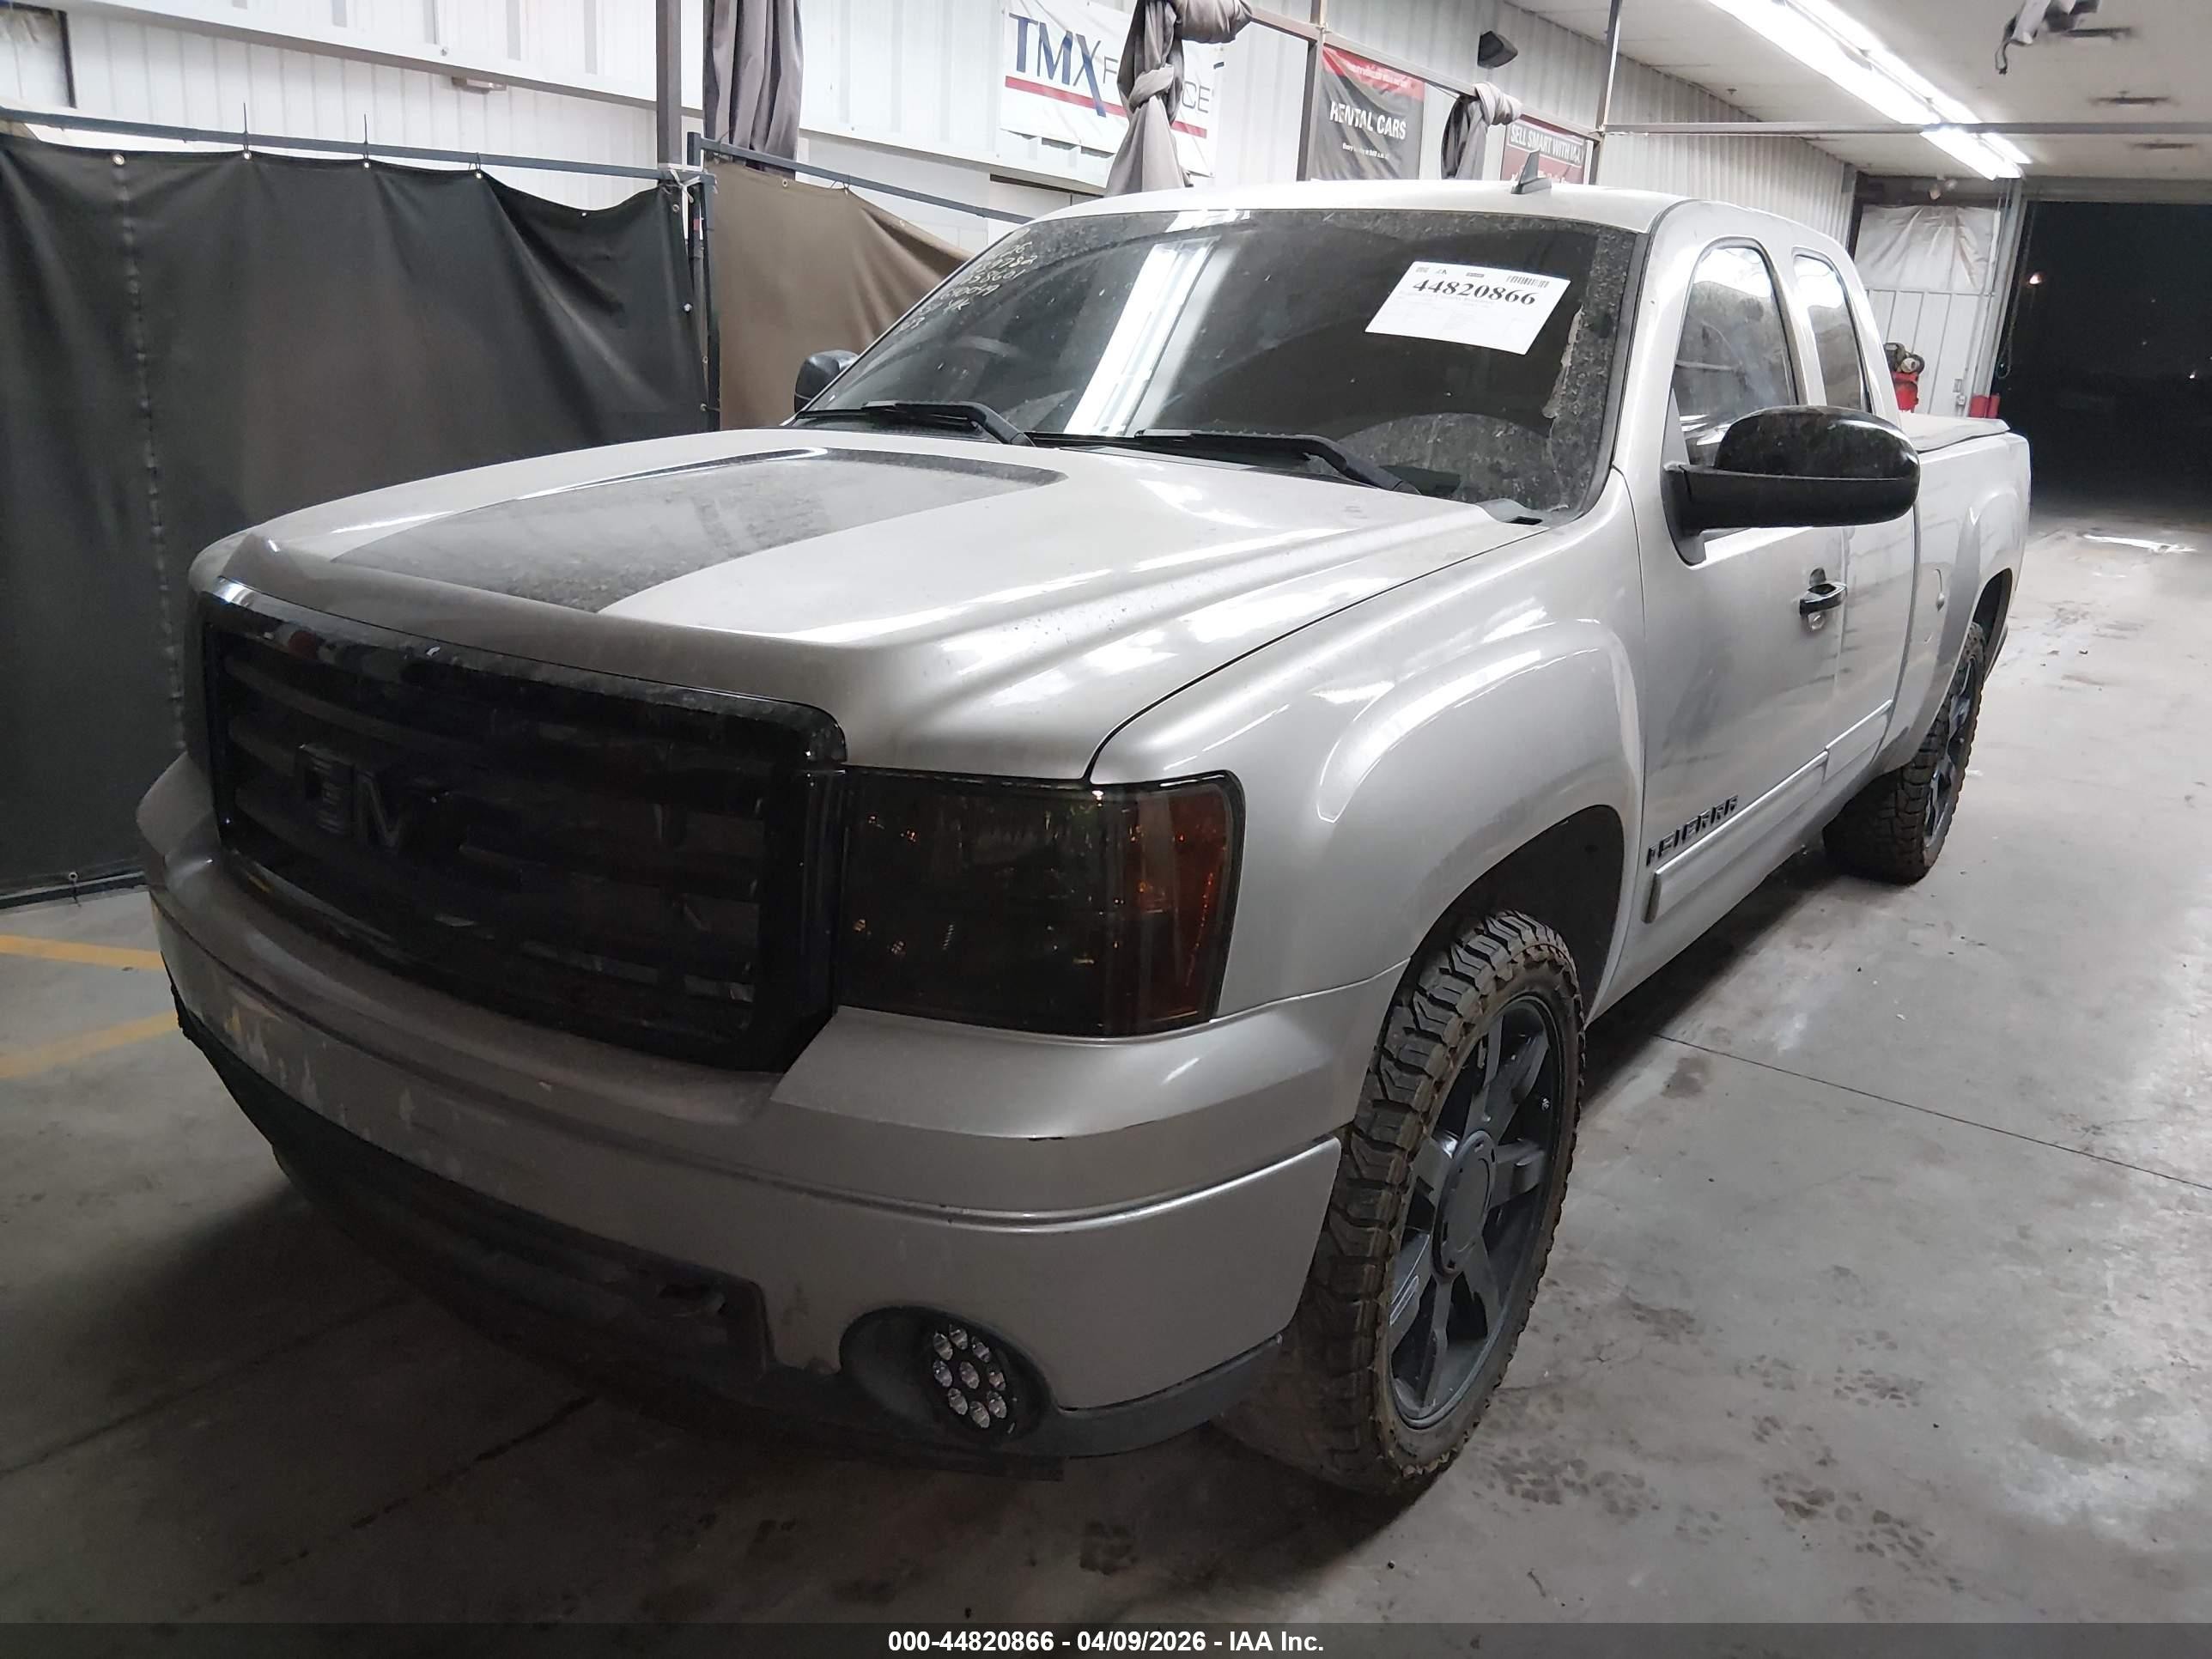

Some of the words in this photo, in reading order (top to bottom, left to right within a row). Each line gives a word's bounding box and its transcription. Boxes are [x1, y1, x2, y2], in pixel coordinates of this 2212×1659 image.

[1009, 12, 1107, 118] TMX
[1329, 100, 1374, 131] RENTAL
[1376, 114, 1407, 140] CARS
[1510, 124, 1527, 147] SELL
[1527, 130, 1553, 154] SMART
[1413, 279, 1540, 306] 44820866
